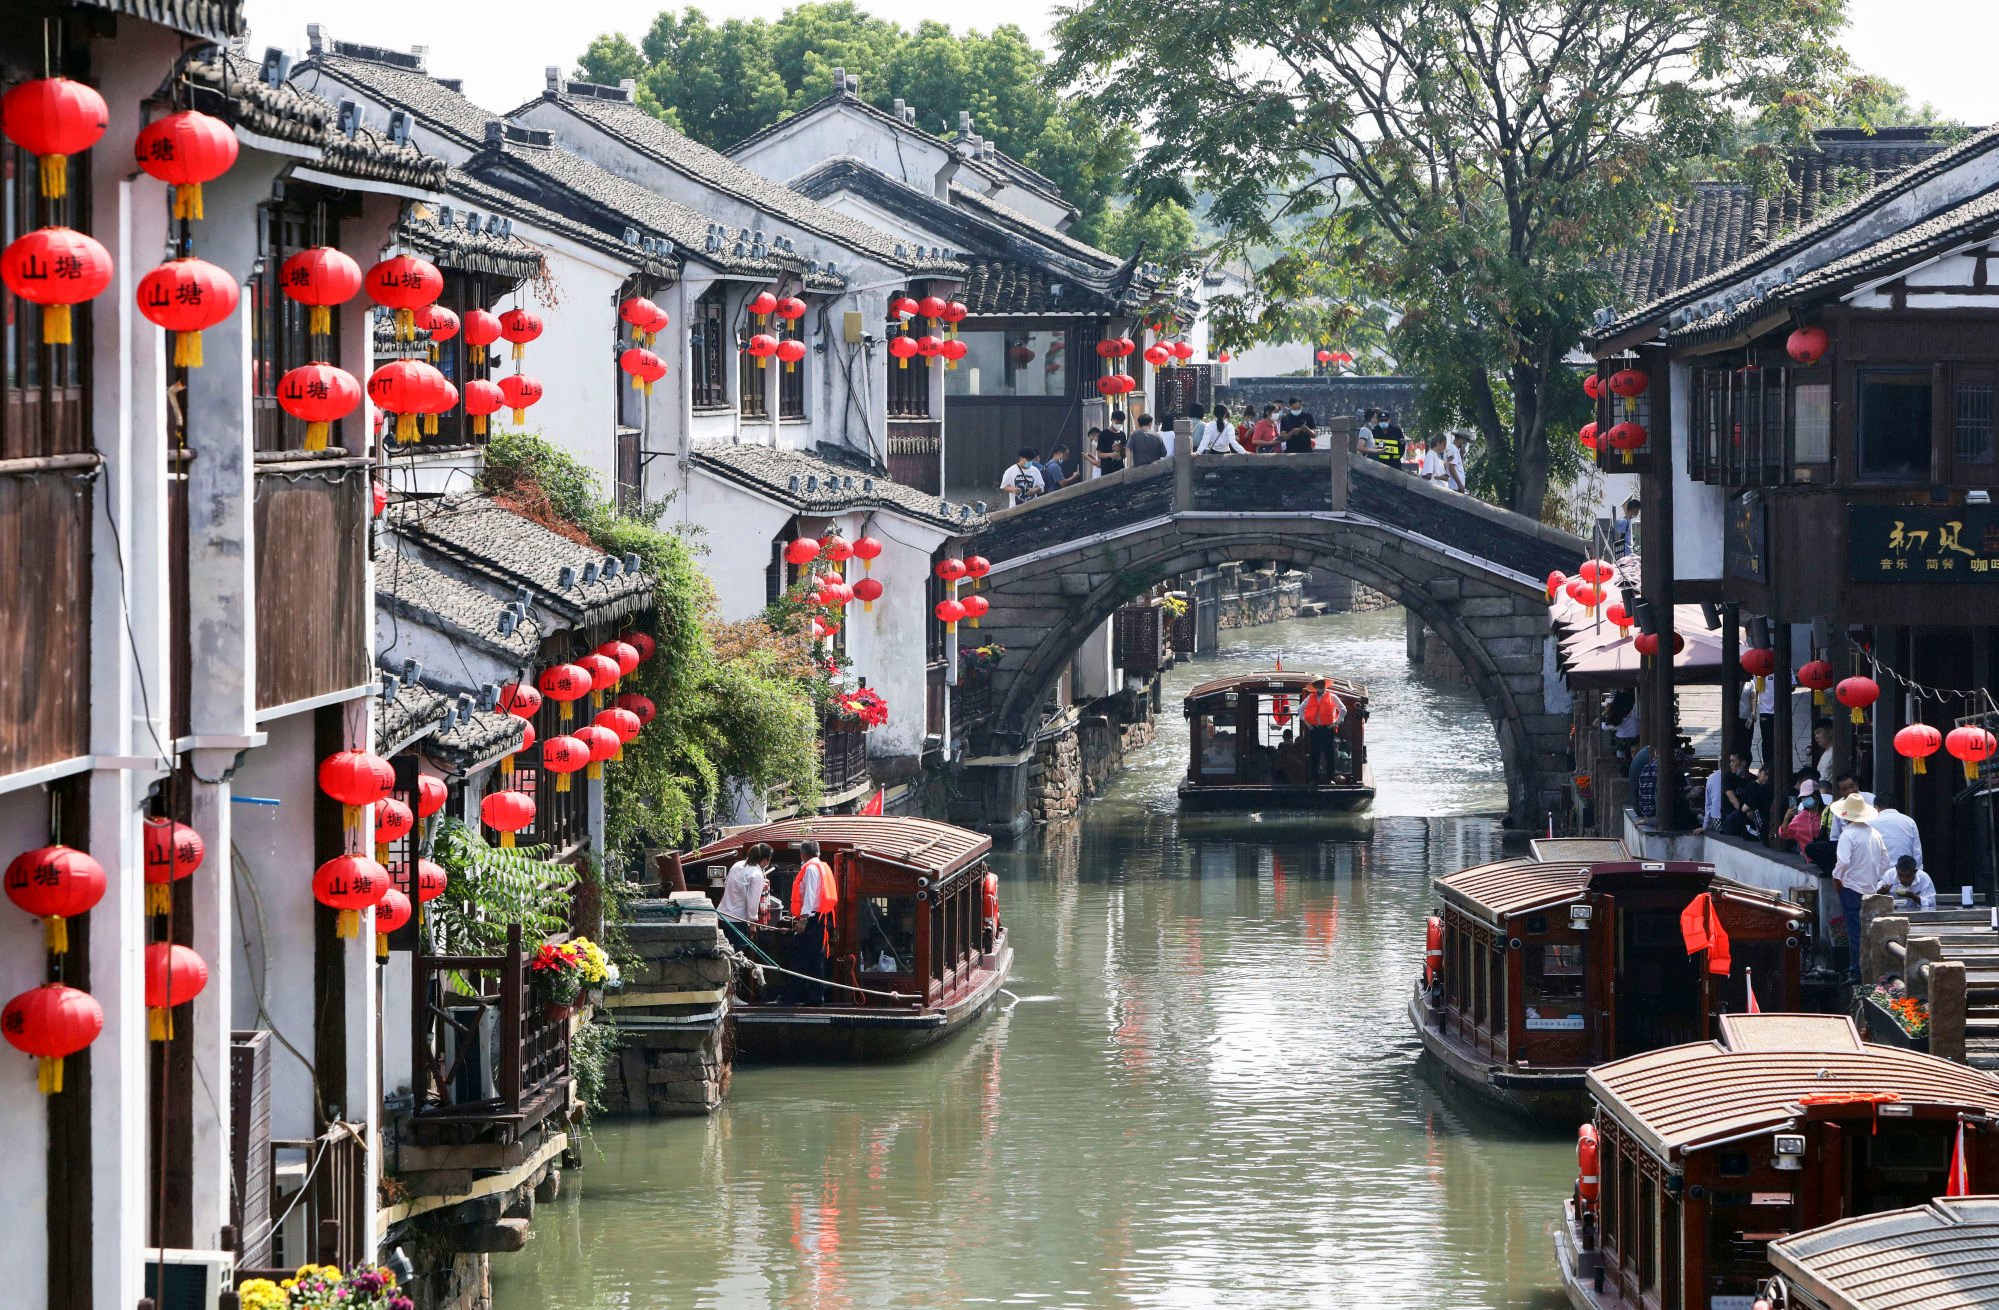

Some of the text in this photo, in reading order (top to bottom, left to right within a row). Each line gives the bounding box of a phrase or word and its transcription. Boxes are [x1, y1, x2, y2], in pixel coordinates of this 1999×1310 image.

[22, 254, 83, 280] 山塘
[381, 271, 421, 290] 山塘
[148, 281, 203, 307] 山塘
[429, 317, 456, 331] 山塘
[512, 319, 538, 333] 山塘
[285, 380, 328, 400] 山塘
[1889, 520, 1975, 556] 初见
[1880, 558, 1908, 570] 音乐
[1926, 558, 1955, 570] 简餐
[543, 678, 572, 692] 山塘
[543, 750, 571, 763] 山塘
[150, 842, 196, 866] 山塘
[11, 863, 61, 889] 山塘
[330, 876, 373, 896] 山塘
